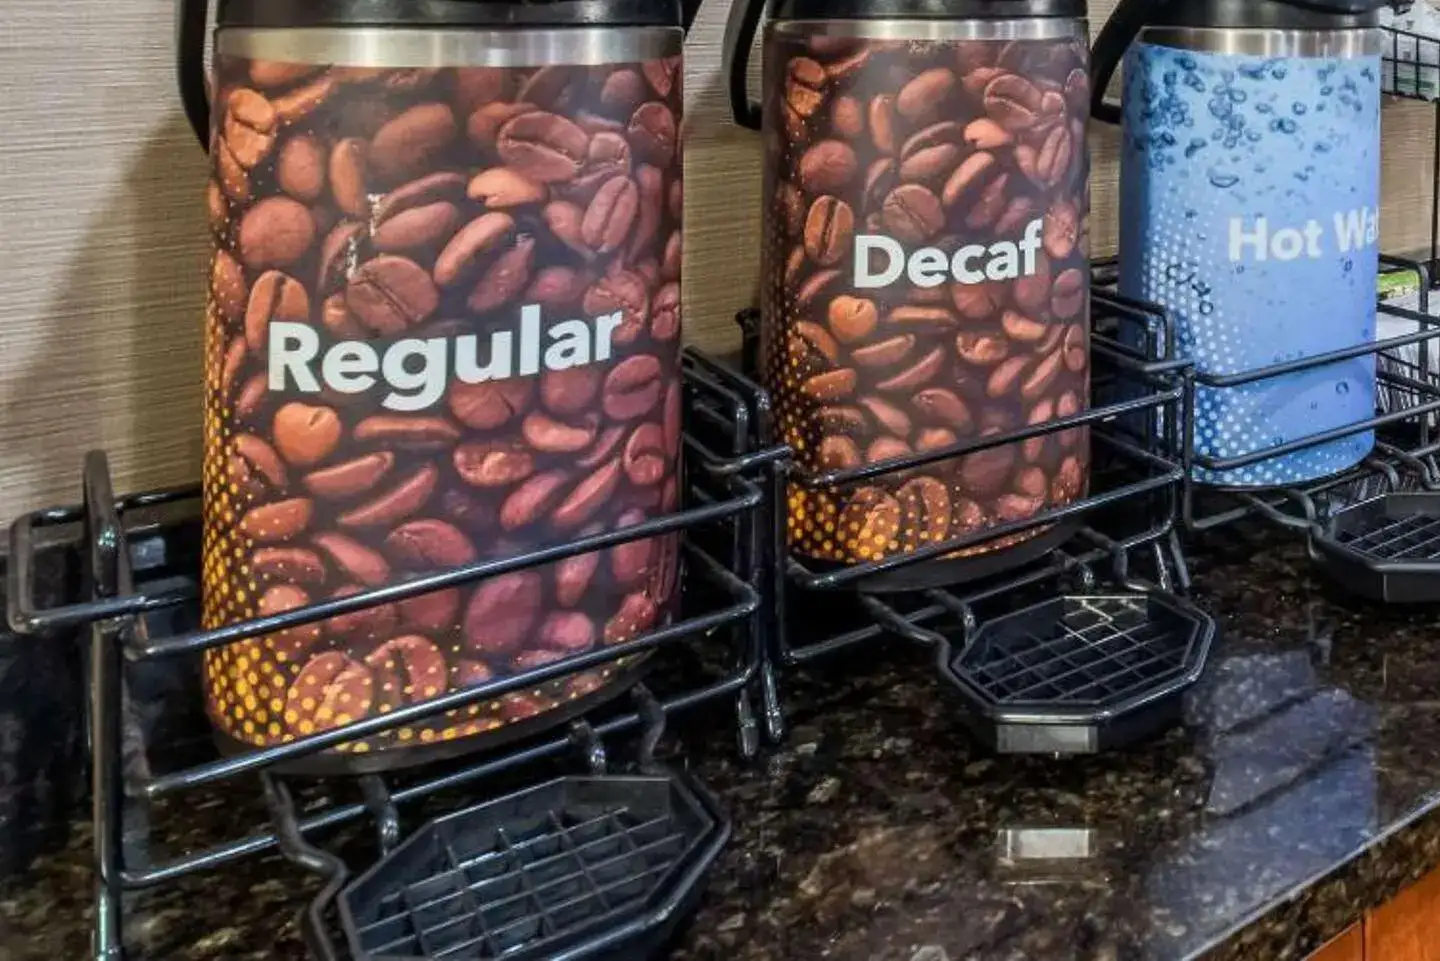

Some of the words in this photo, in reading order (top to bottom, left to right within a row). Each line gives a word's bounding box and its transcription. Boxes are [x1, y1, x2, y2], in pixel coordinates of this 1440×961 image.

[854, 218, 1044, 288] Decaf
[1229, 217, 1323, 262] Hot
[1333, 205, 1379, 253] Wa
[268, 304, 623, 411] Regular
